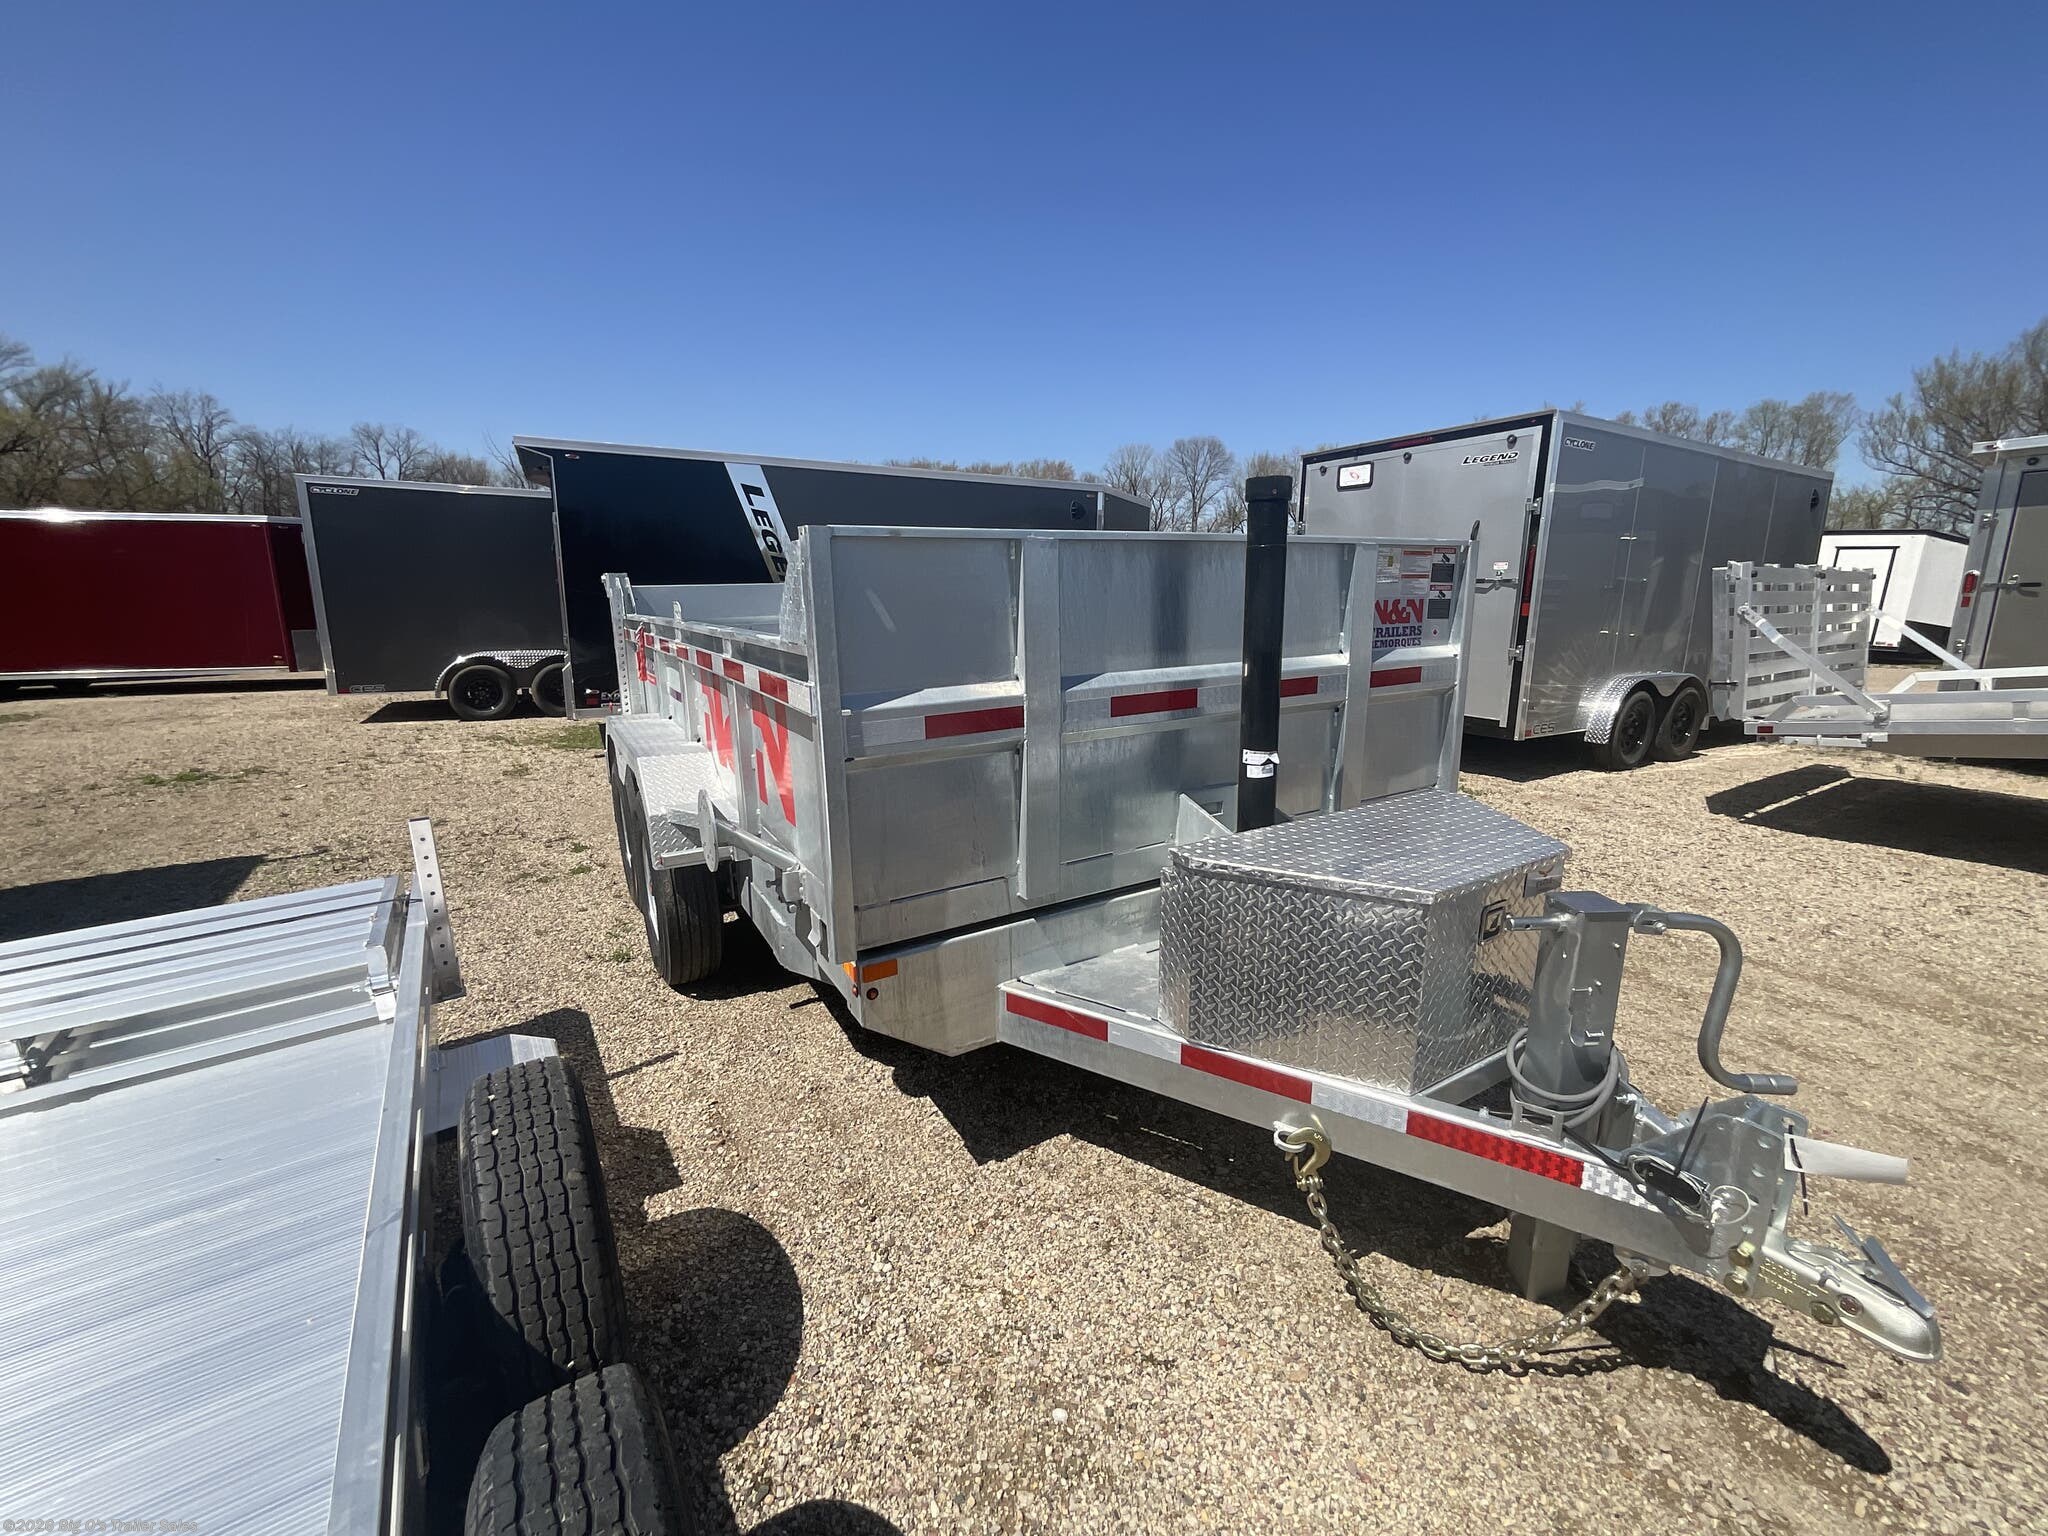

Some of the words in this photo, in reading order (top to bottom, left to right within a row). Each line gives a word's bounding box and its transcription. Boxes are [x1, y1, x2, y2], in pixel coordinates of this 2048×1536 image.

[1565, 438, 1595, 450] CYCLONE
[1463, 452, 1518, 464] LEGEND
[310, 486, 359, 495] CYCLONE
[740, 483, 787, 582] LEGE
[1373, 625, 1422, 638] RAILERS
